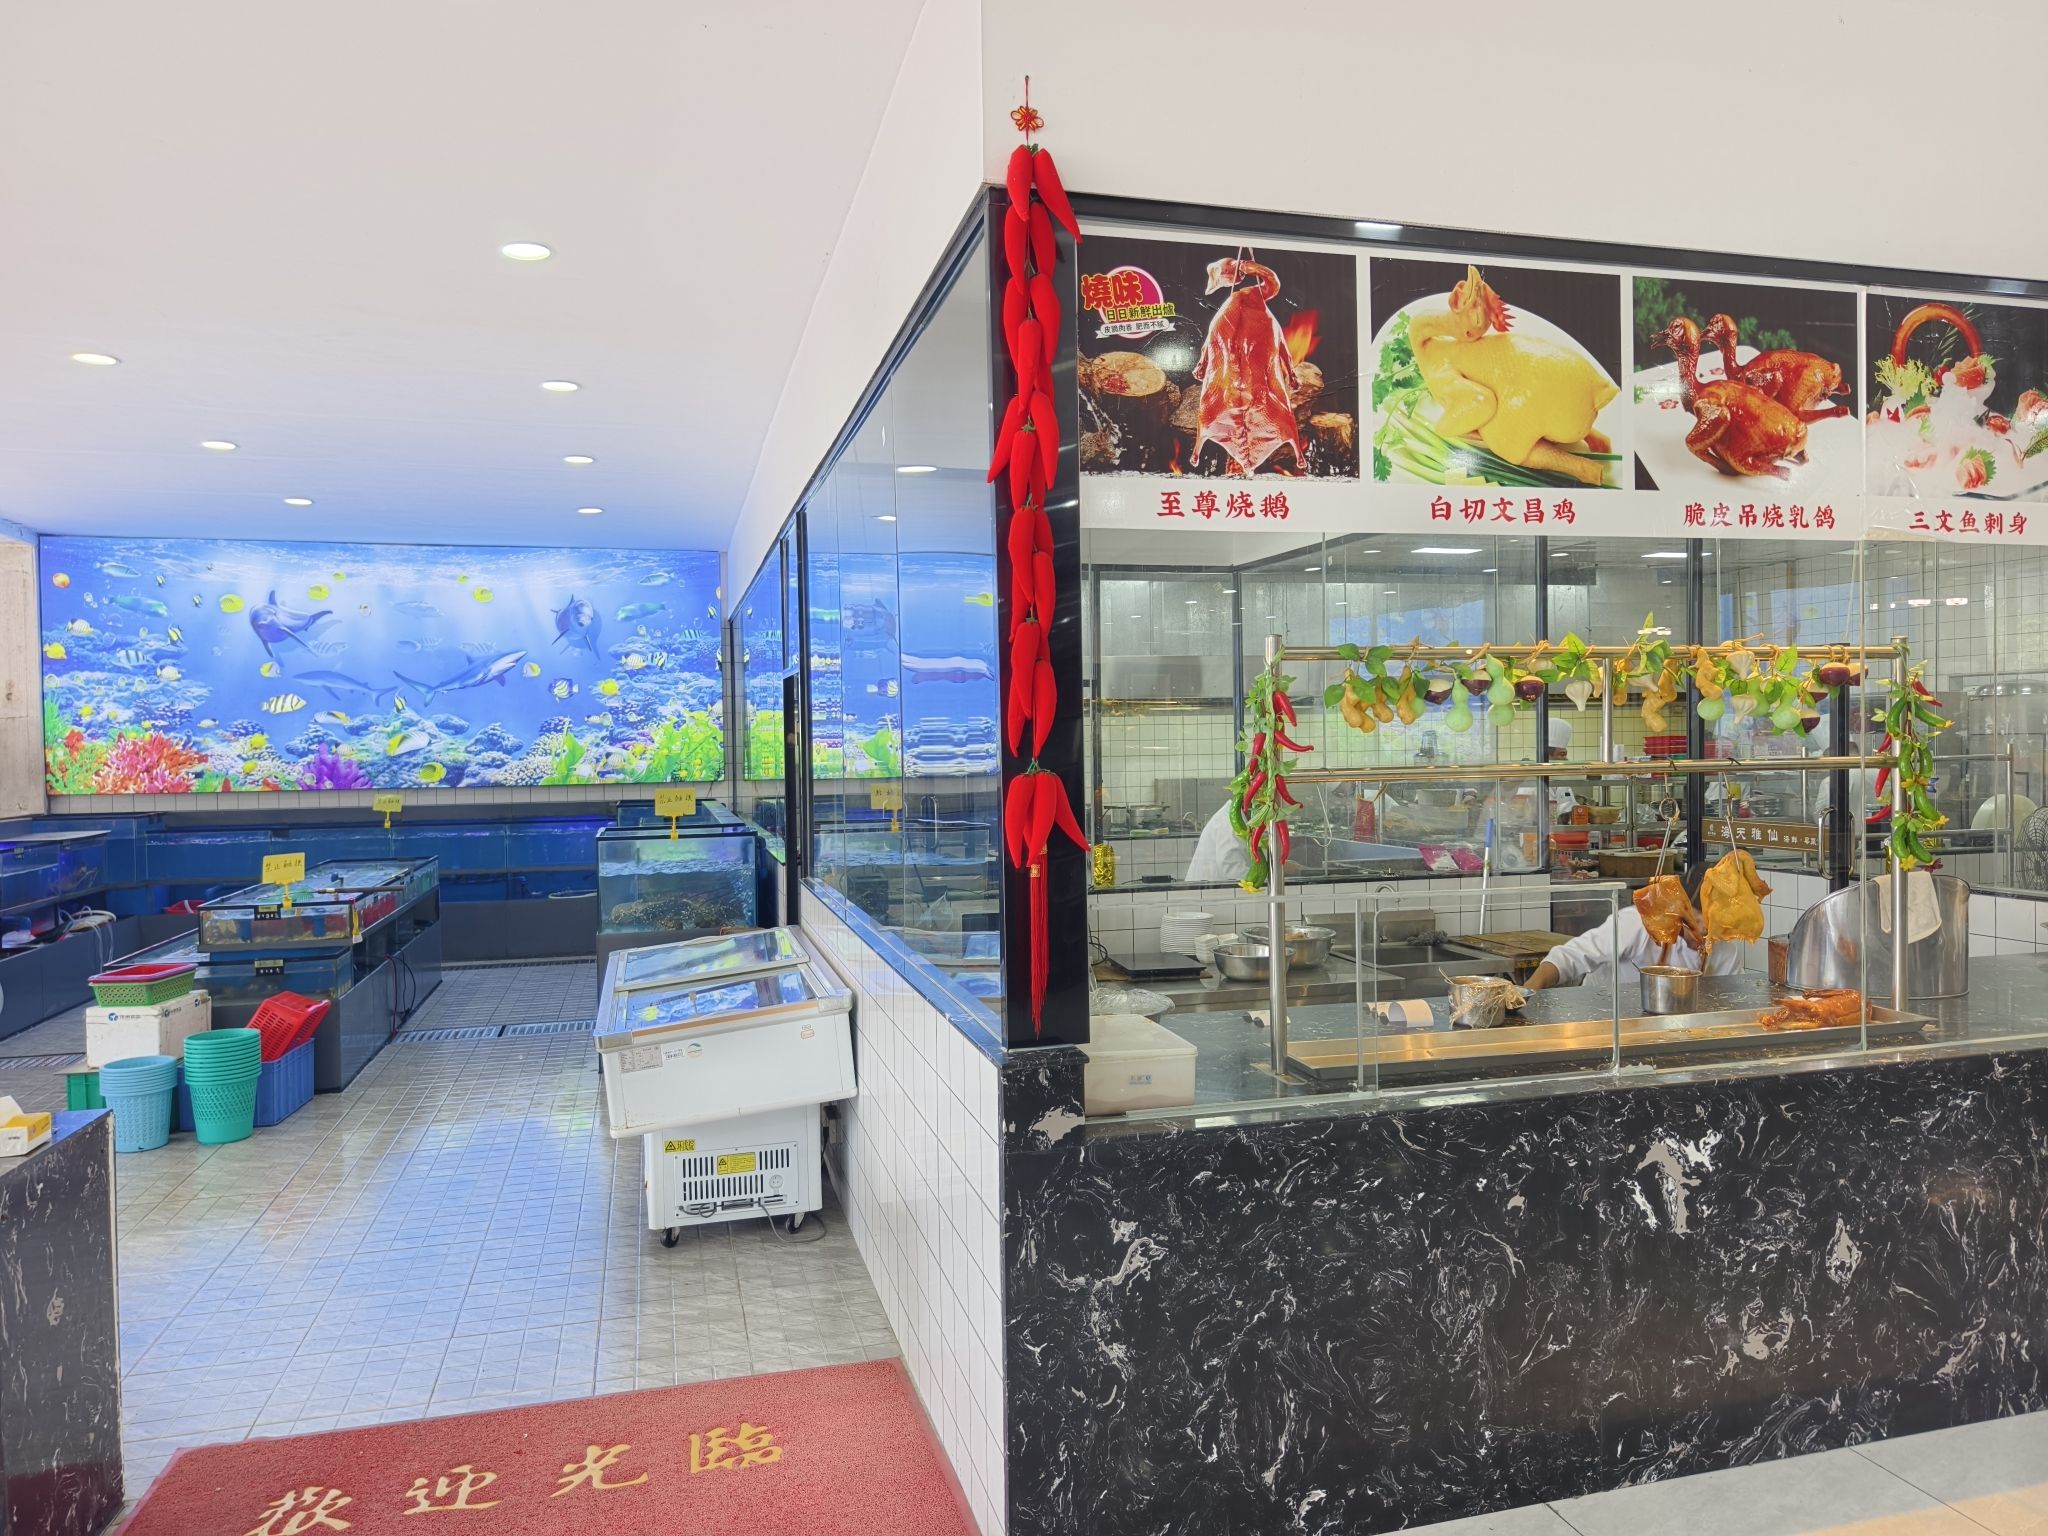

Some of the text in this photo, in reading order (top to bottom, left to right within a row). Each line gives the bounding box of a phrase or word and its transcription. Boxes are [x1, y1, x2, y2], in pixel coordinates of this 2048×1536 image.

[1081, 271, 1143, 310] 燒味
[1157, 490, 1290, 520] 至尊烧鹅
[1431, 495, 1576, 524] 白切文昌鸡
[1683, 502, 1836, 530] 脆皮吊烧乳鸽
[1909, 509, 2028, 535] 三文鱼刺身
